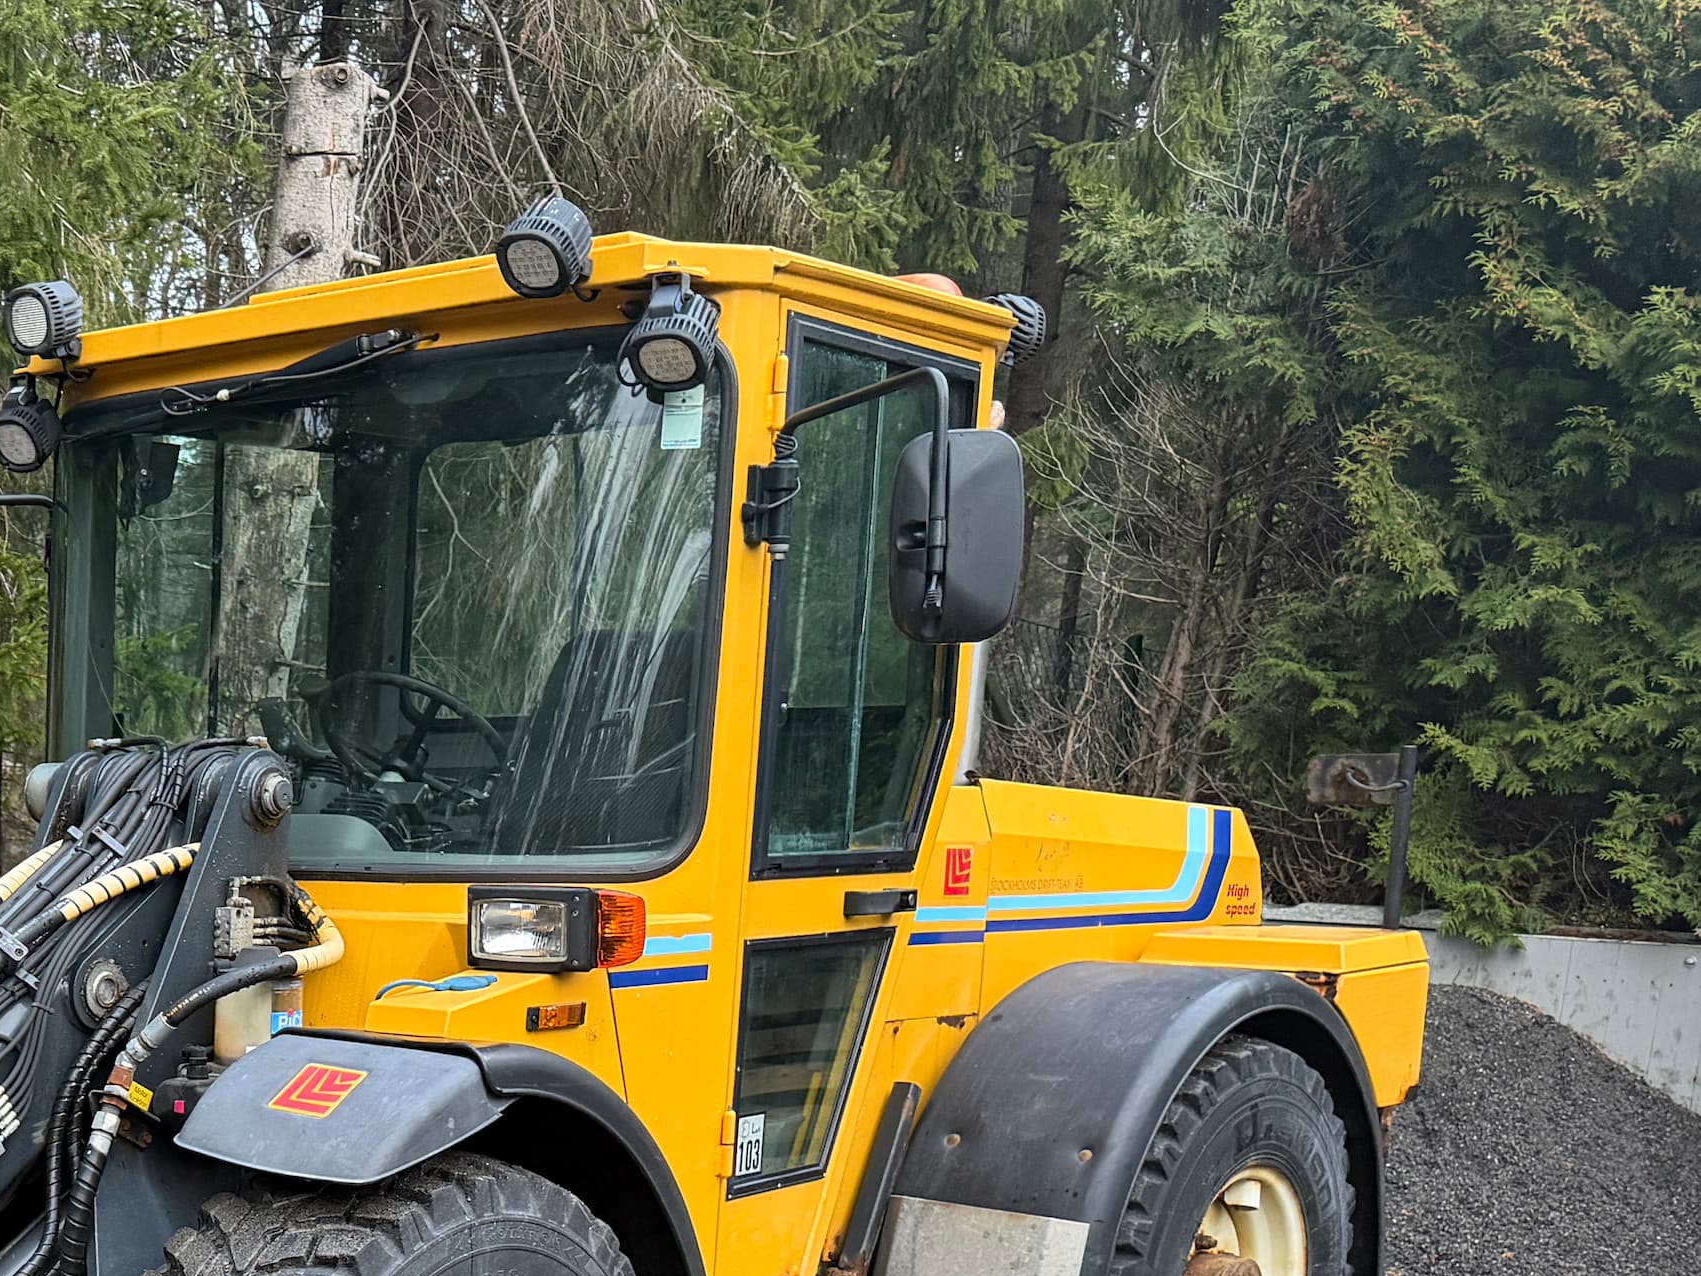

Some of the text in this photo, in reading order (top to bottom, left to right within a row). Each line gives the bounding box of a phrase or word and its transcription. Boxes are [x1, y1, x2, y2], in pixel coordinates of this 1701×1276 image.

[1227, 884, 1249, 900] High
[1225, 902, 1256, 919] speed
[739, 1138, 761, 1172] 103
